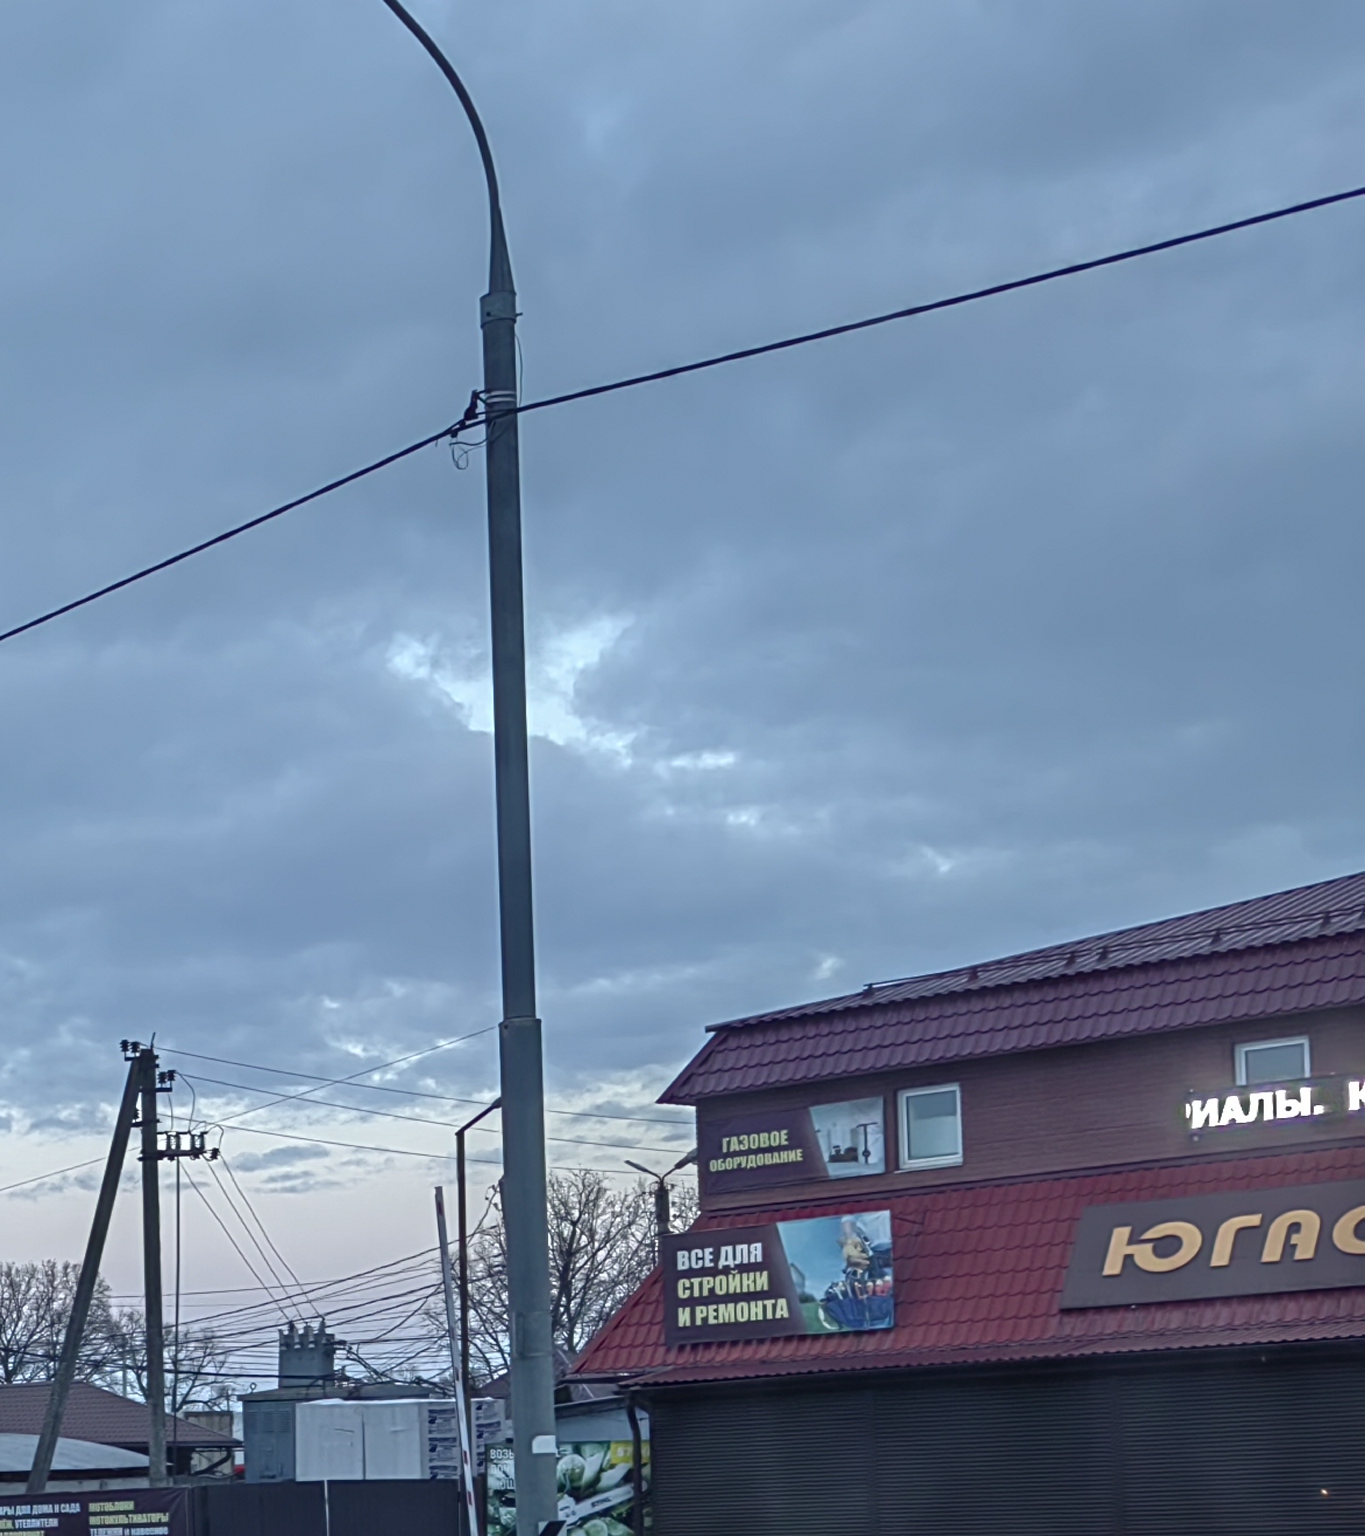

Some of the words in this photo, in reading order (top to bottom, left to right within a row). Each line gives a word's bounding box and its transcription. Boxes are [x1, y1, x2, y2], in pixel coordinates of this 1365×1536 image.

[1186, 1087, 1324, 1129] ИАЛЫ.
[722, 1130, 789, 1153] ГАЗОВОЕ
[709, 1149, 803, 1172] ОБОРУДОВАНИЕ
[677, 1248, 714, 1271] ВСЕ
[718, 1242, 762, 1269] ДЛЯ
[677, 1270, 769, 1299] СТРОЙКИ
[678, 1307, 691, 1327] И
[695, 1298, 790, 1326] РЕМОНТА
[490, 1448, 515, 1459] ВОЗЬ
[15, 1504, 31, 1516] ДЛЯ
[31, 1503, 54, 1515] ДОМА
[60, 1502, 81, 1514] САДА
